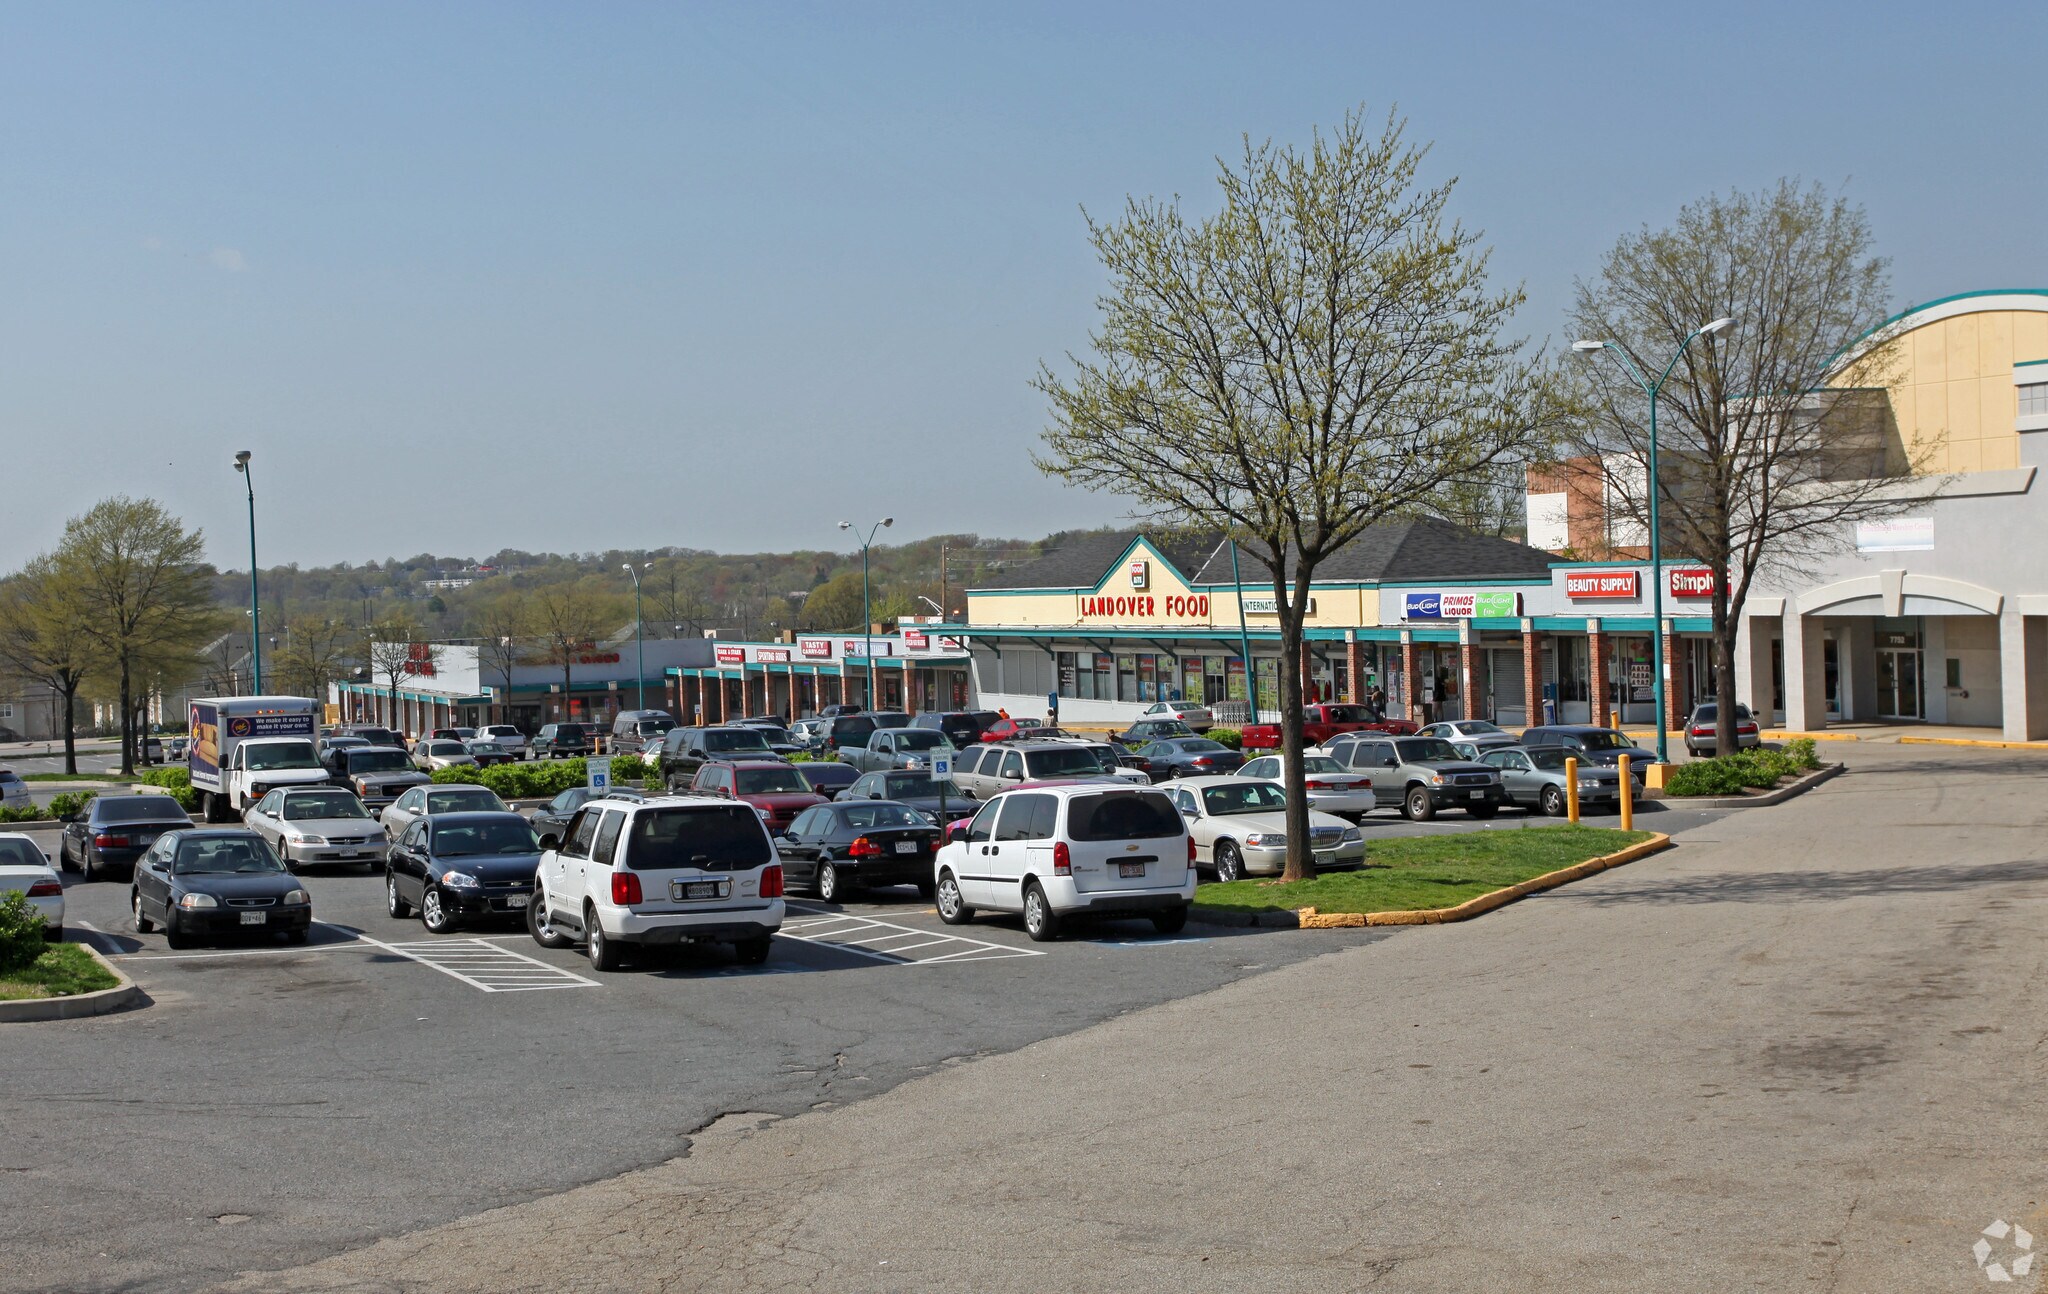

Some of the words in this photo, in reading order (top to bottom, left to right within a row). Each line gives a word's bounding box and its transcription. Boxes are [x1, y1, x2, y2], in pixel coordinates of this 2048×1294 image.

[1567, 578, 1599, 592] BEAUTY
[1600, 577, 1633, 592] SUPPLY
[1081, 596, 1155, 617] LANDOVER
[1166, 595, 1209, 617] FOOD
[1443, 596, 1474, 606] PRIMOS
[1444, 608, 1472, 616] LIQUOR
[805, 641, 824, 649] TASTY
[757, 651, 775, 661] SPORTING
